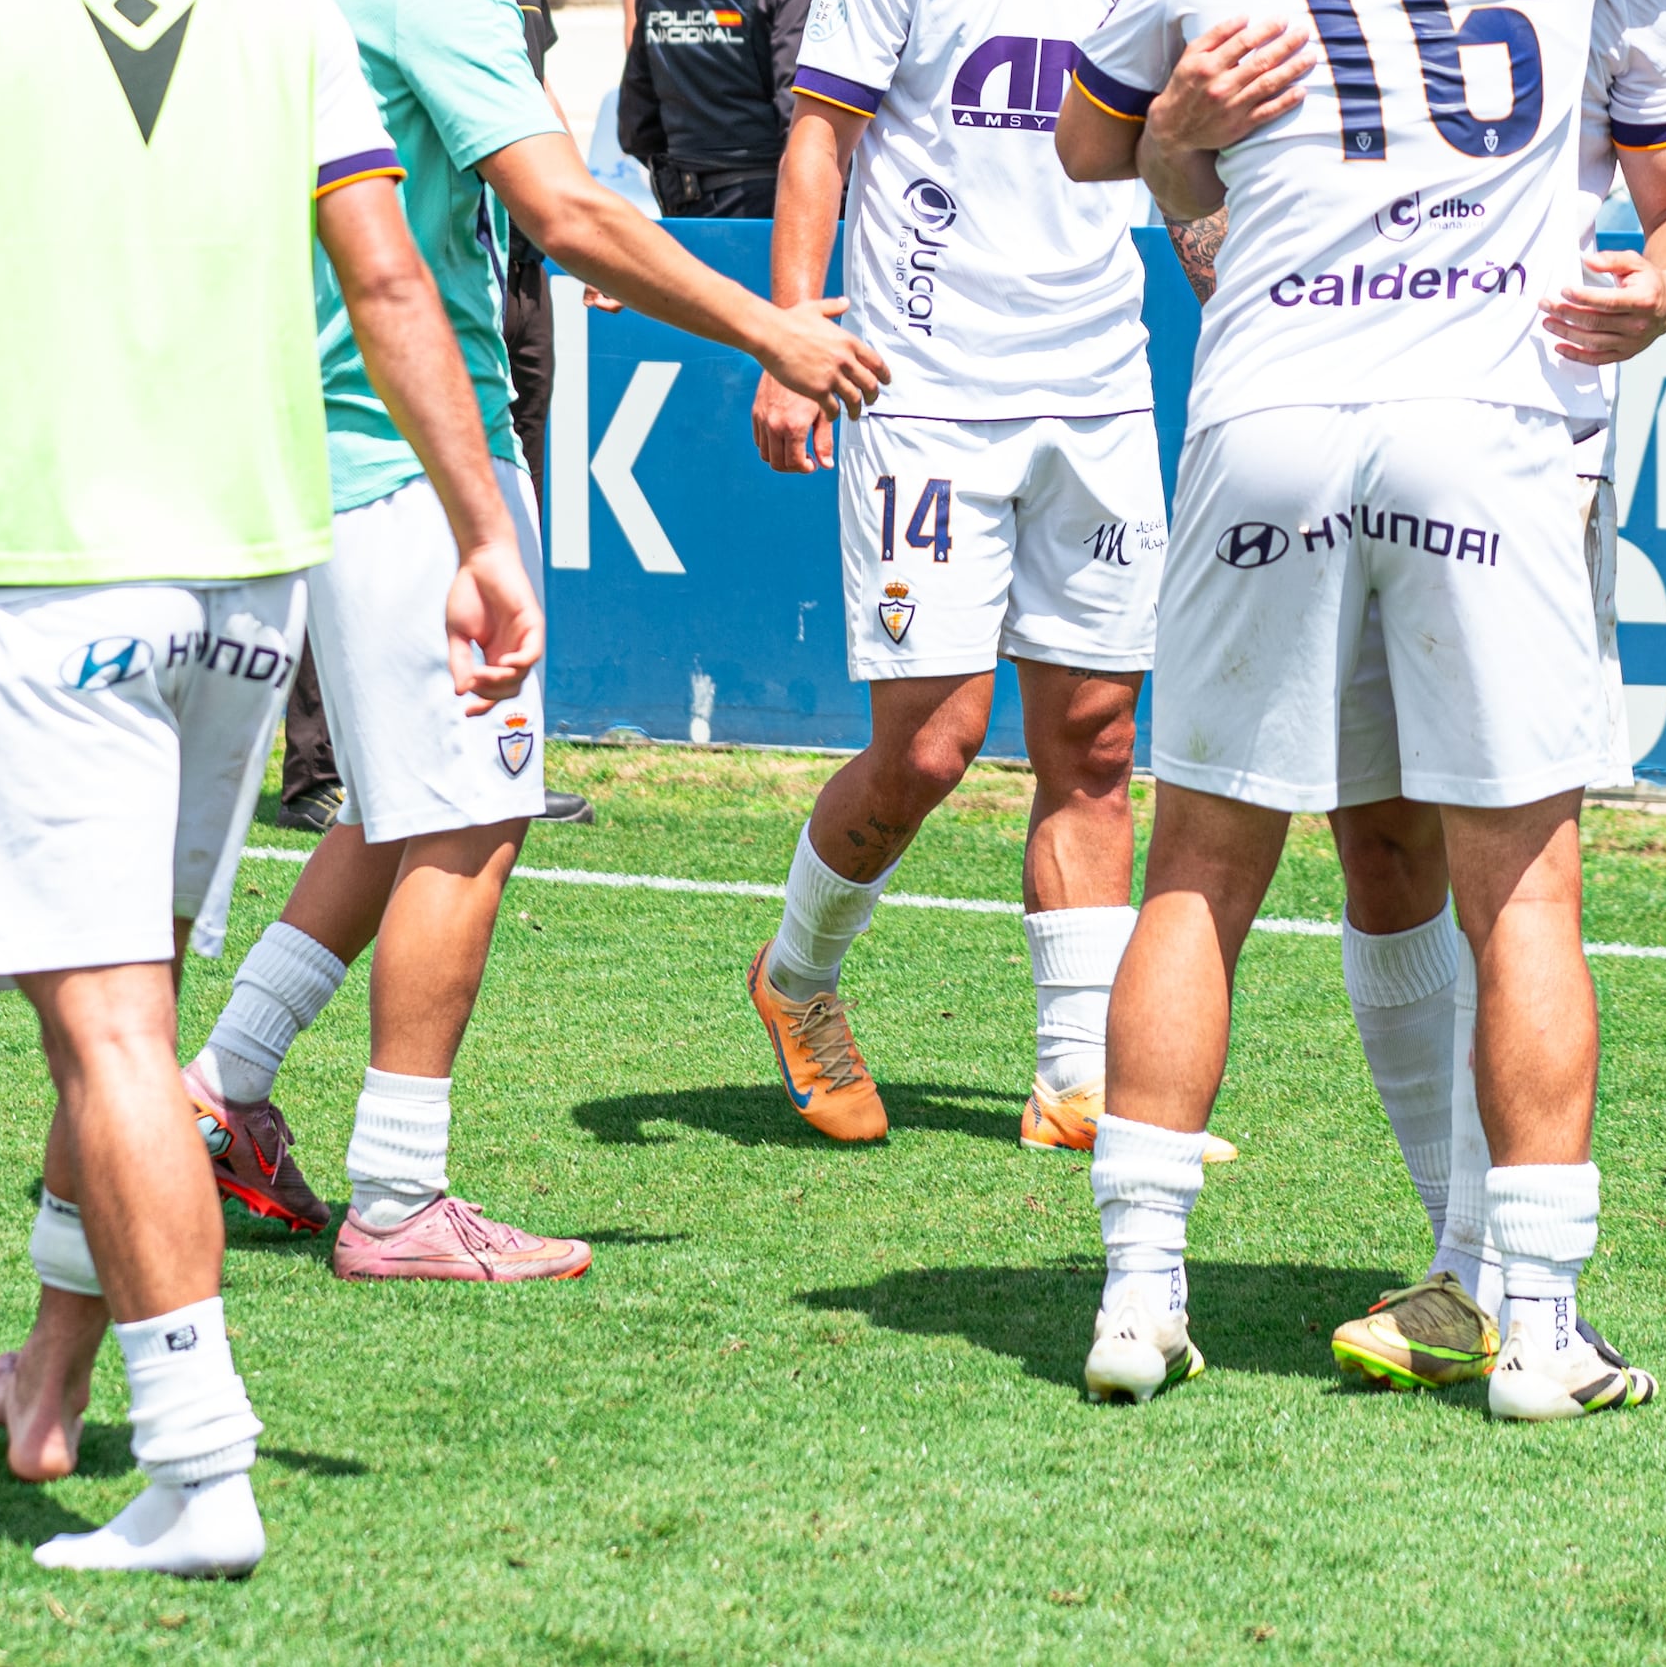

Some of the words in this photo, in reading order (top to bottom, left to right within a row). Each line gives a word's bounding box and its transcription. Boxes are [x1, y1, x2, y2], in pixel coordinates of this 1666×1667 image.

[646, 11, 718, 27] POLICIA
[645, 27, 745, 45] NACIONAL
[958, 113, 1047, 129] AMSY
[1429, 199, 1486, 219] clibo
[1269, 260, 1528, 308] calderón
[874, 475, 953, 564] 14
[1300, 503, 1501, 567] HYUNDAI
[1169, 1267, 1182, 1311] OCKS
